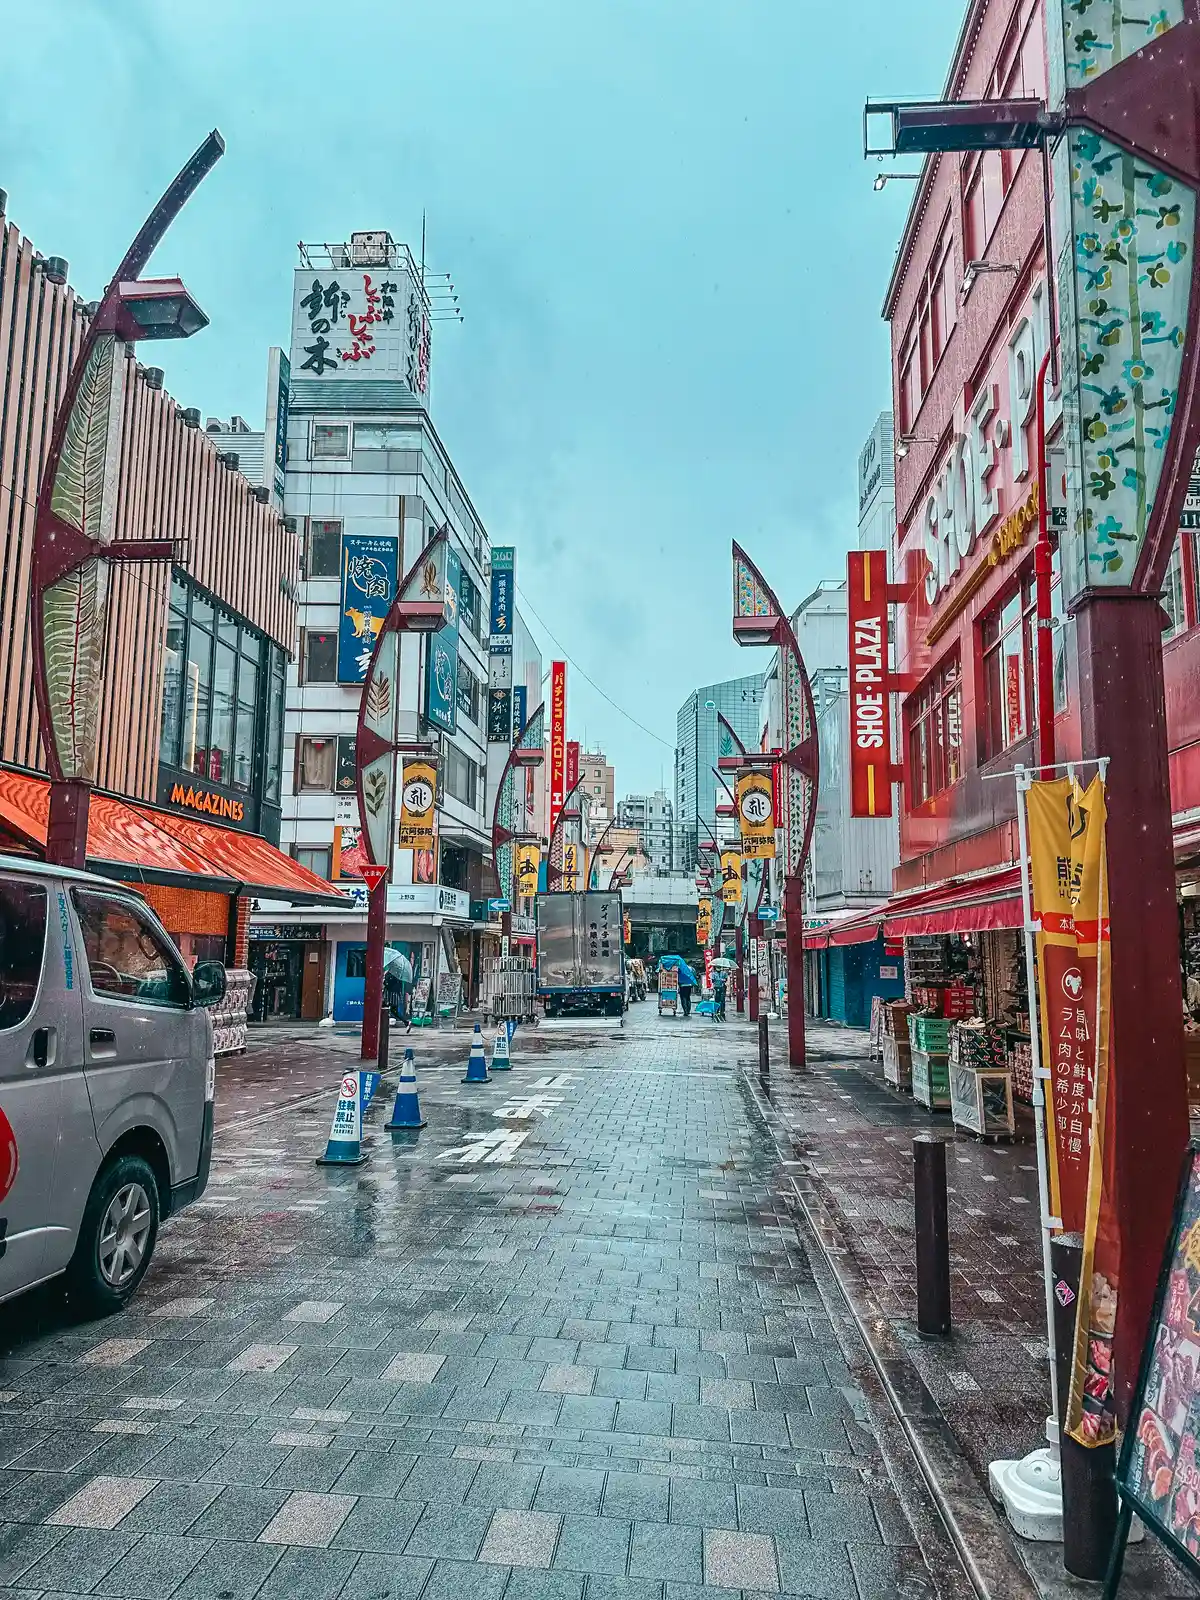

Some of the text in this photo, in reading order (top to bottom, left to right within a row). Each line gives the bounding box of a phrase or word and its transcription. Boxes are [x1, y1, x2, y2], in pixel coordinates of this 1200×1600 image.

[171, 782, 244, 821] MAGAZINES
[338, 1100, 356, 1111] 駐輪
[336, 1112, 355, 1123] 禁止
